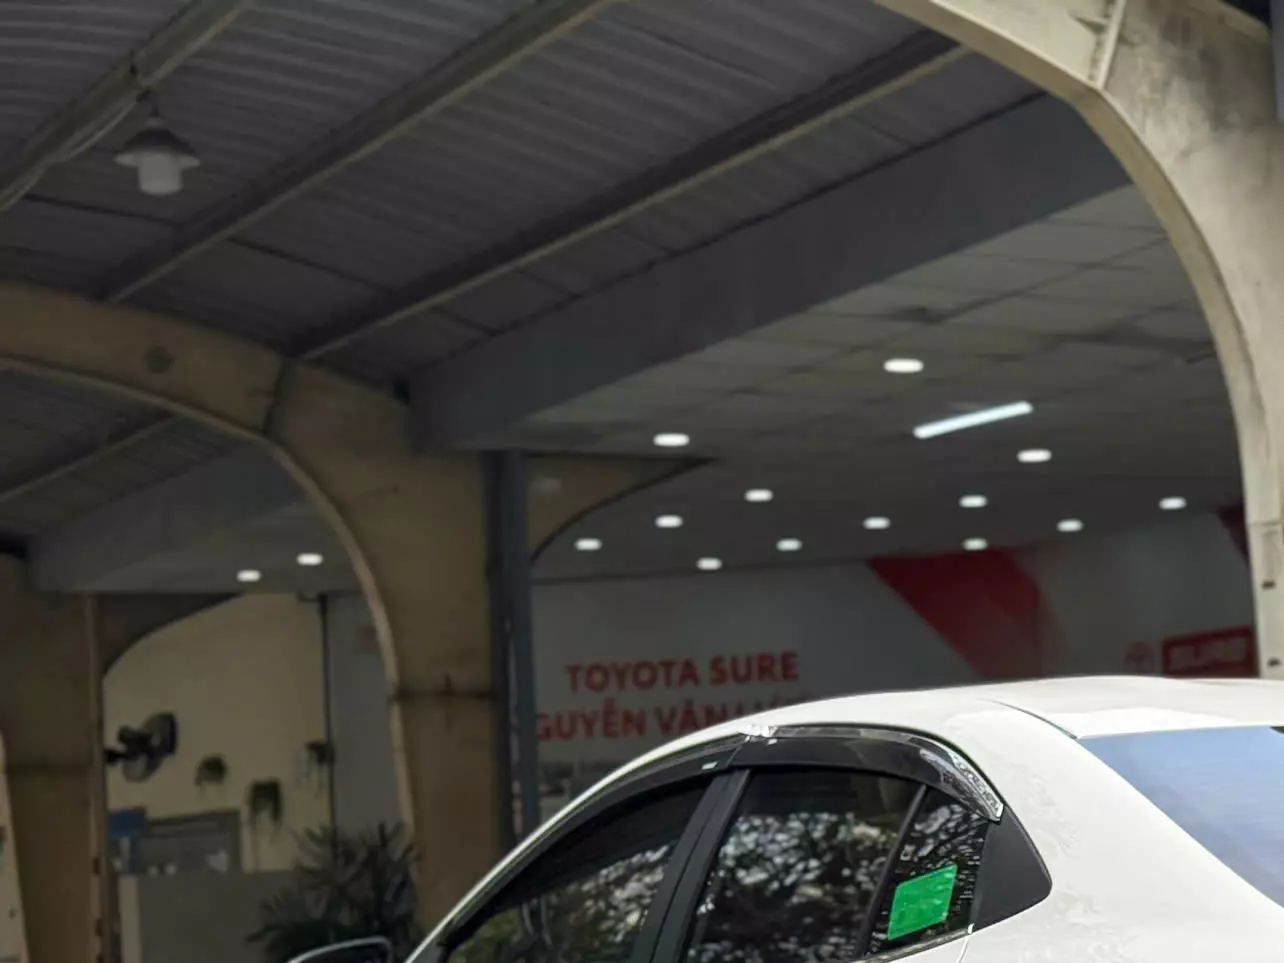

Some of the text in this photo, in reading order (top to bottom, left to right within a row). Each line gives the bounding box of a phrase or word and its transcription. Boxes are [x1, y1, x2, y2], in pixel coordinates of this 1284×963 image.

[564, 651, 798, 693] TOYOTA SURE
[537, 697, 648, 741] GUYỄN
